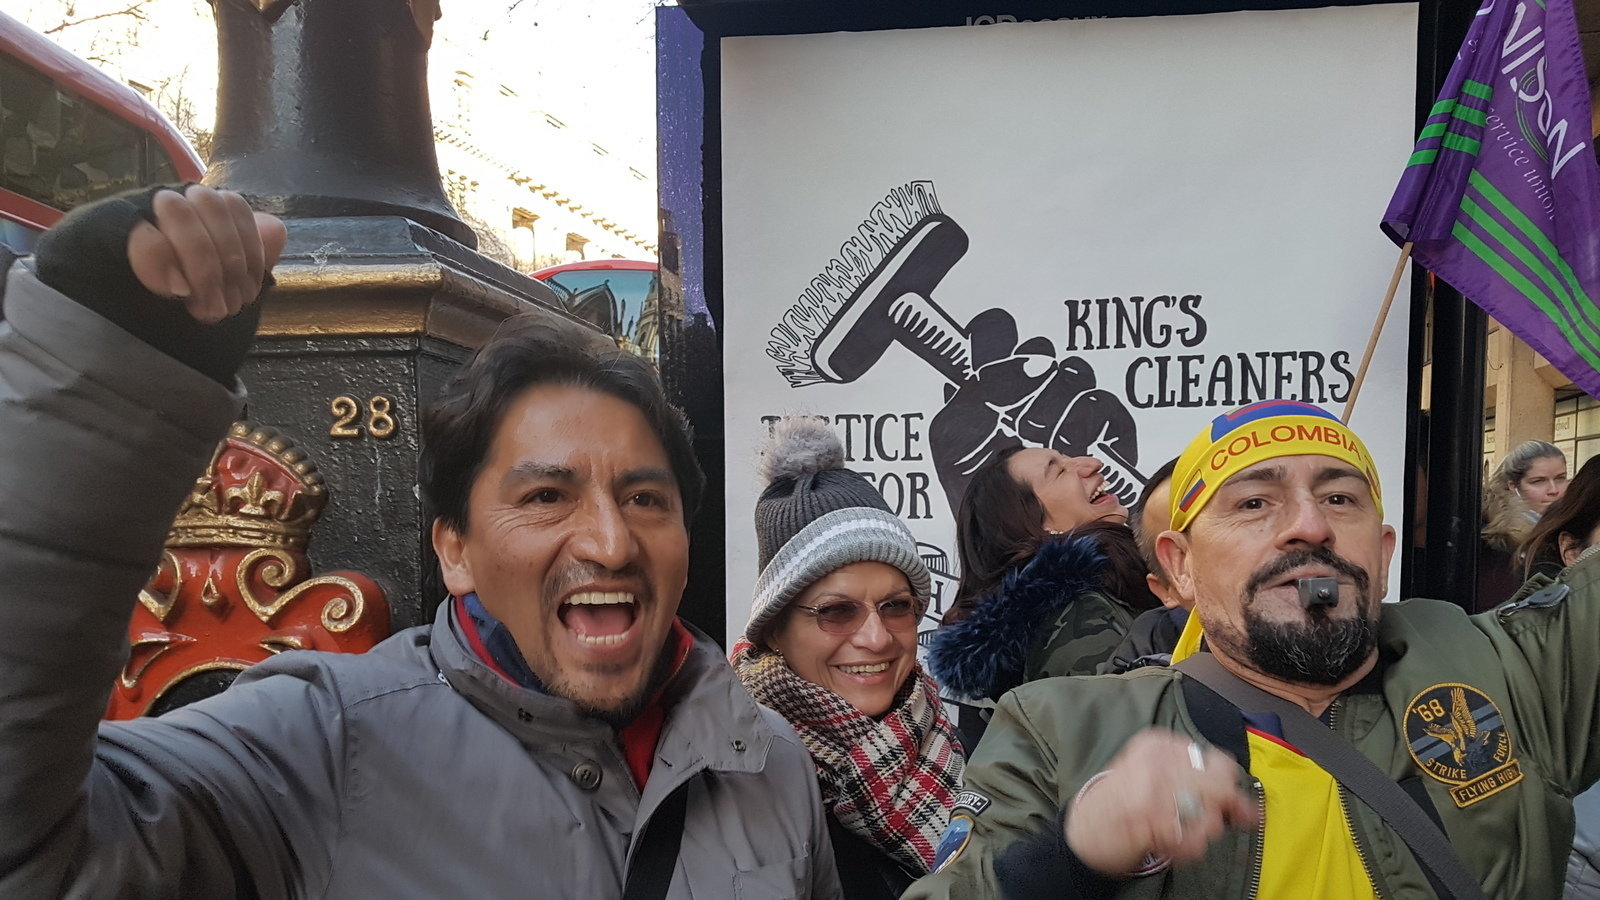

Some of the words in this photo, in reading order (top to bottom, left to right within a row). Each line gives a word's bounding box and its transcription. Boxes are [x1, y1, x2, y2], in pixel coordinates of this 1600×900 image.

[1064, 294, 1208, 351] KING'S
[1125, 350, 1356, 409] CLEANERS
[330, 395, 394, 437] 28
[760, 412, 925, 462] TICE
[1210, 424, 1362, 471] COLOMBIA
[857, 471, 934, 519] OR
[1425, 757, 1468, 779] STRIKE
[1458, 778, 1497, 801] FLYING
